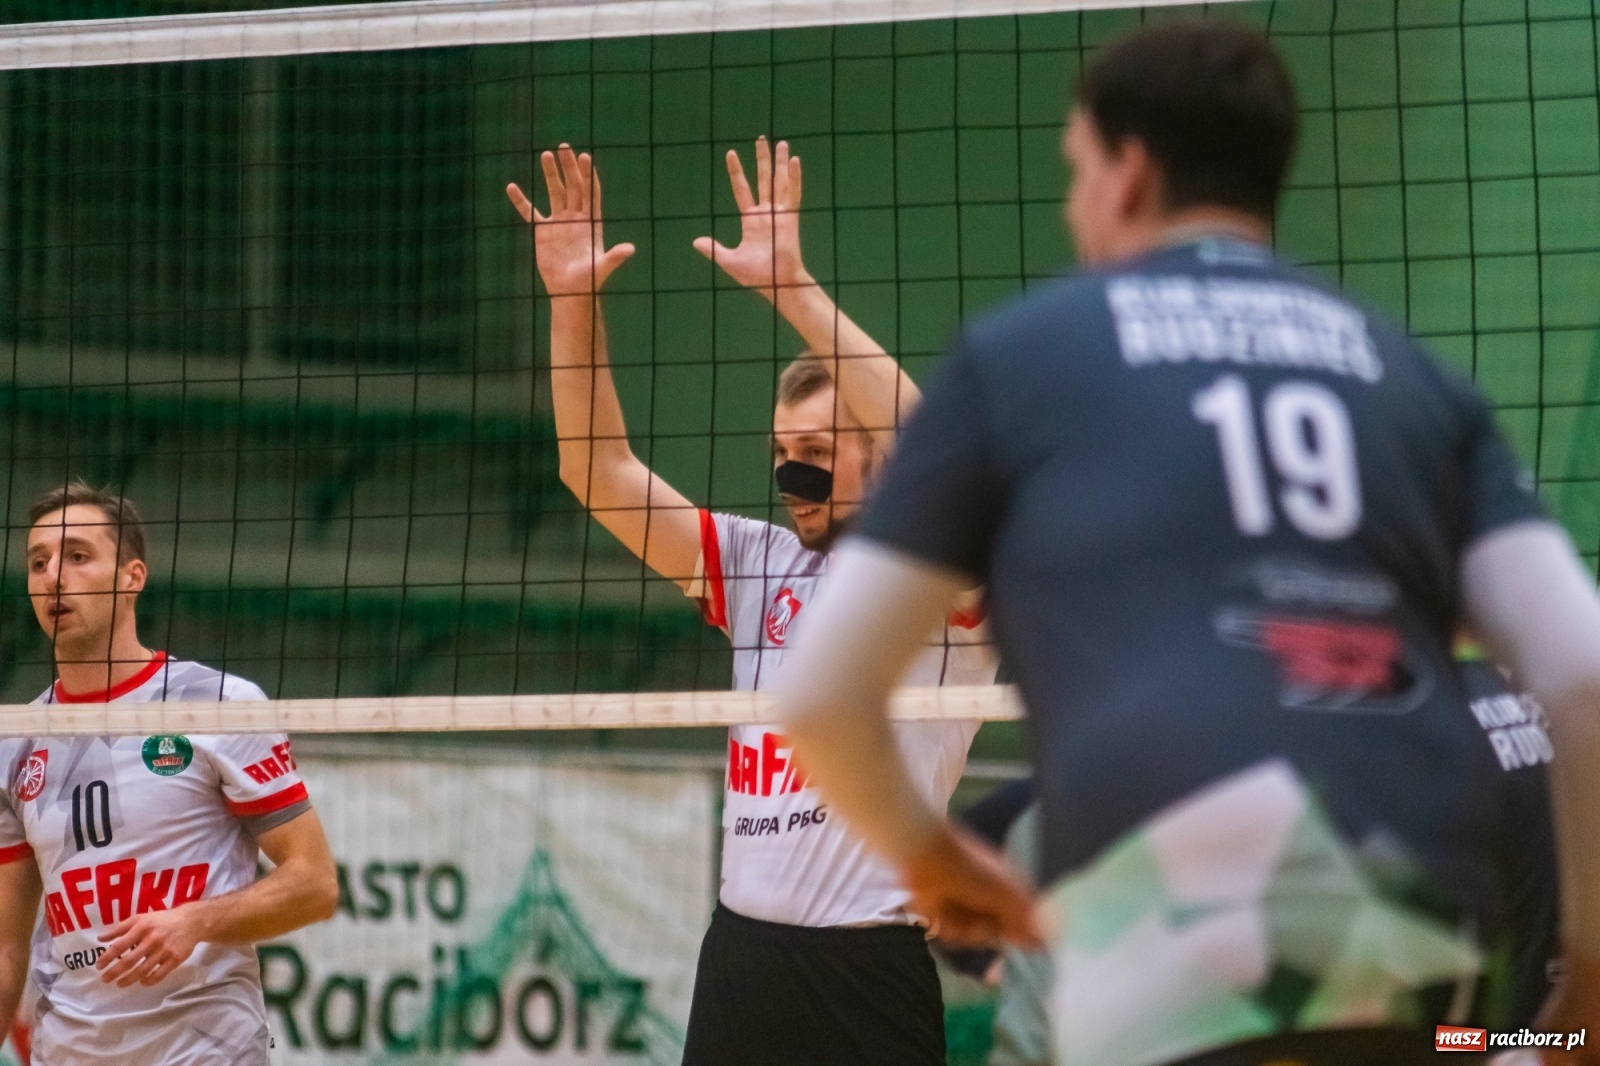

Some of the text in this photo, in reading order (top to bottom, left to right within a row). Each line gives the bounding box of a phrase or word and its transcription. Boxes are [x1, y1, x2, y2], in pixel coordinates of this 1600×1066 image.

[1192, 374, 1363, 541] 19
[72, 780, 113, 852] 10
[734, 804, 828, 836] GRUPA PBG
